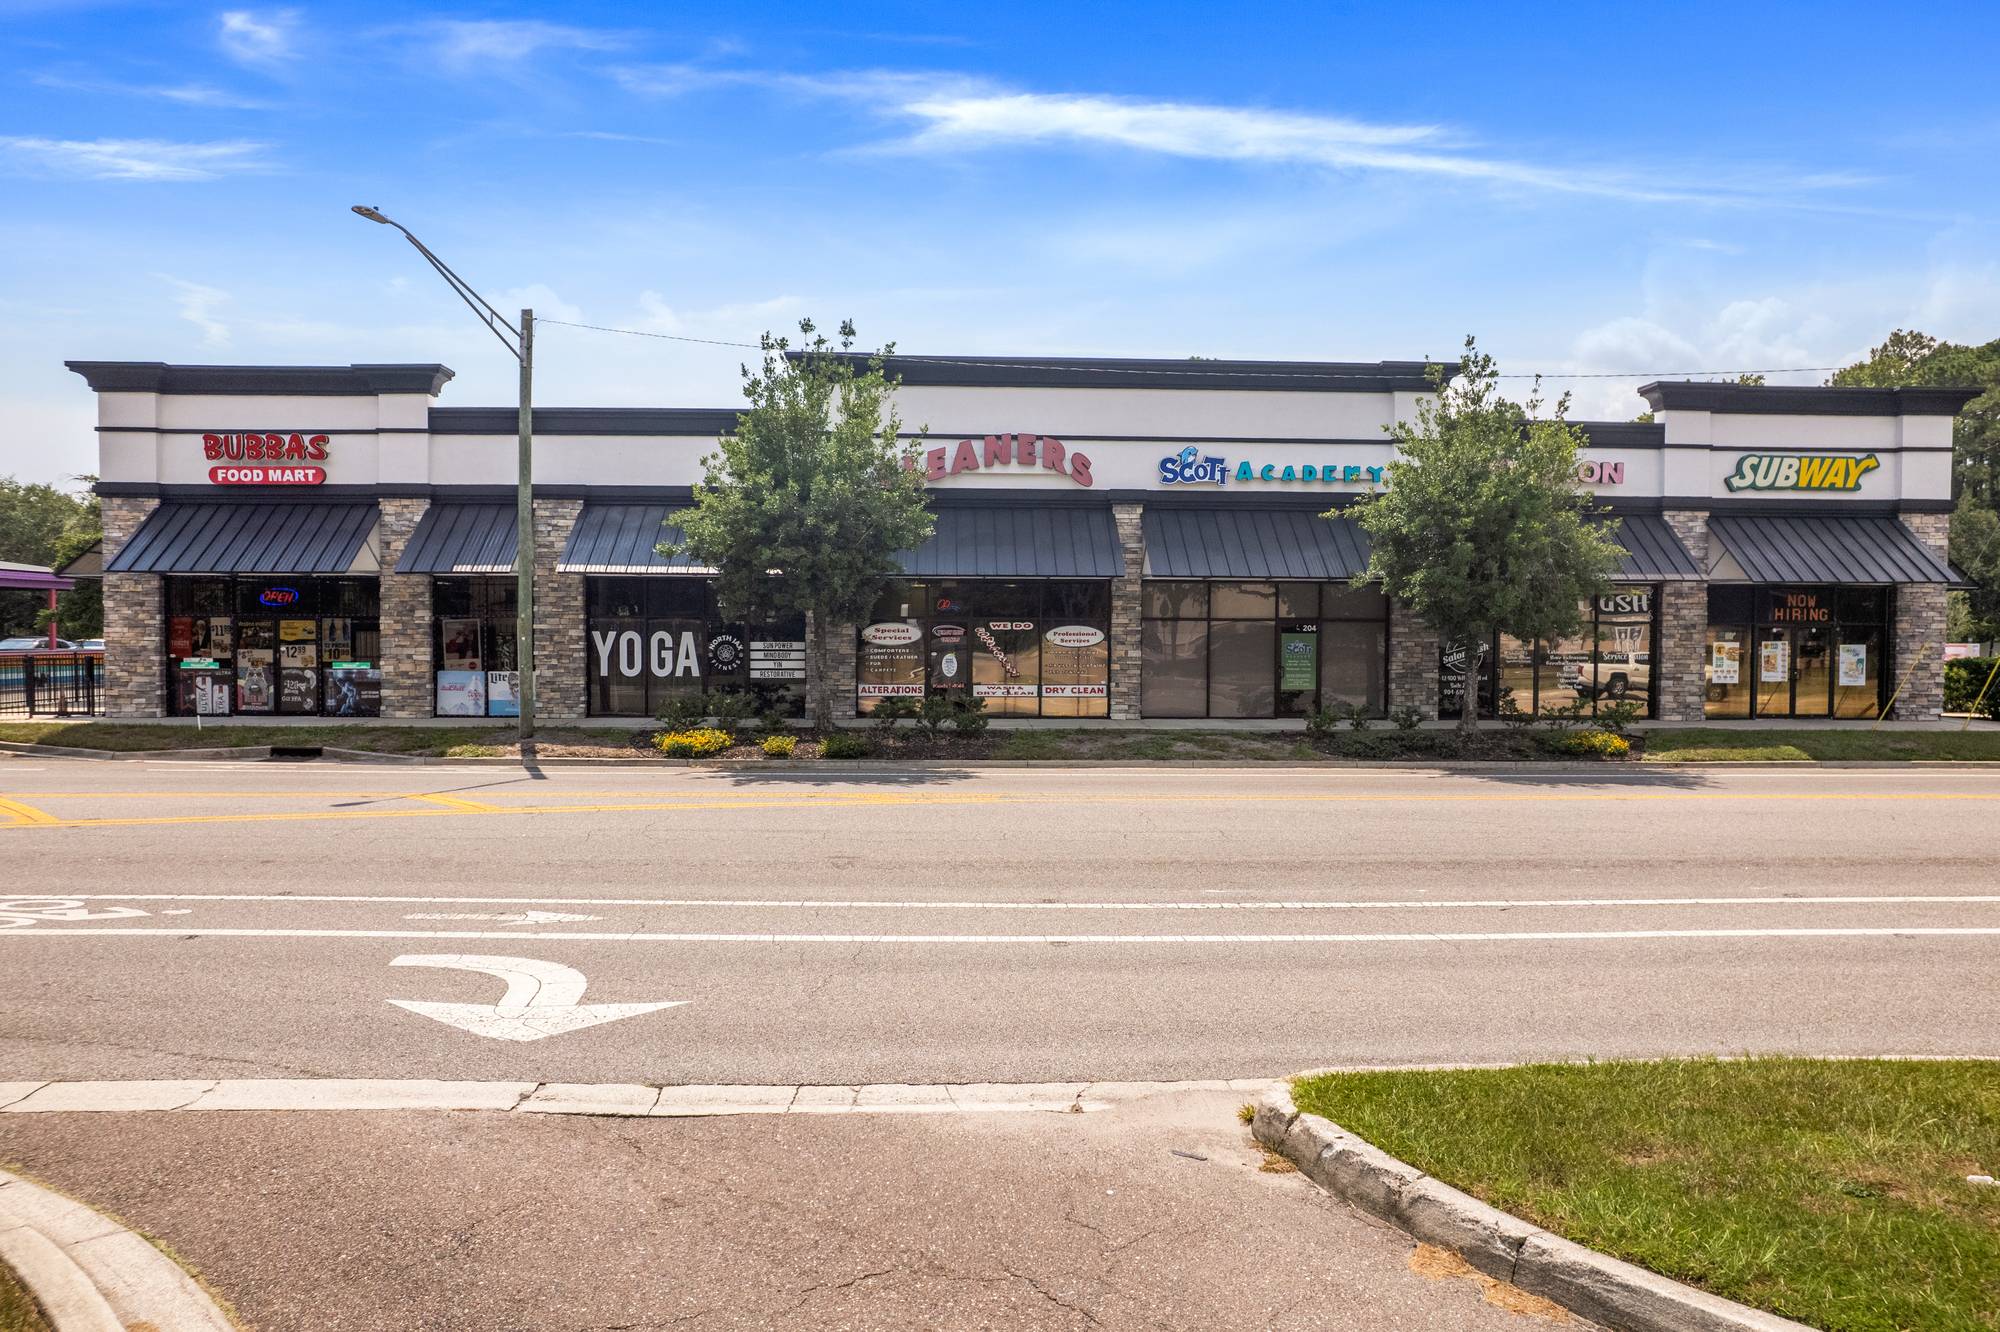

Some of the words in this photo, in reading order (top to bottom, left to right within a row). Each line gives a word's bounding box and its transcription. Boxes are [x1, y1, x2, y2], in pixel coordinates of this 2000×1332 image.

[203, 433, 330, 461] BUBBAS
[217, 469, 263, 482] FOOD
[268, 469, 316, 482] MART
[1235, 460, 1385, 483] ACADEMY
[1729, 455, 1879, 489] SUBWAY
[1787, 594, 1816, 608] NOW
[1774, 608, 1828, 621] HIRING
[708, 634, 732, 651] NORTH
[731, 639, 745, 651] JAX
[592, 630, 700, 677] YOGA
[710, 658, 742, 671] FITNESS
[490, 672, 508, 684] Lite
[860, 686, 923, 694] ALTERATIONS
